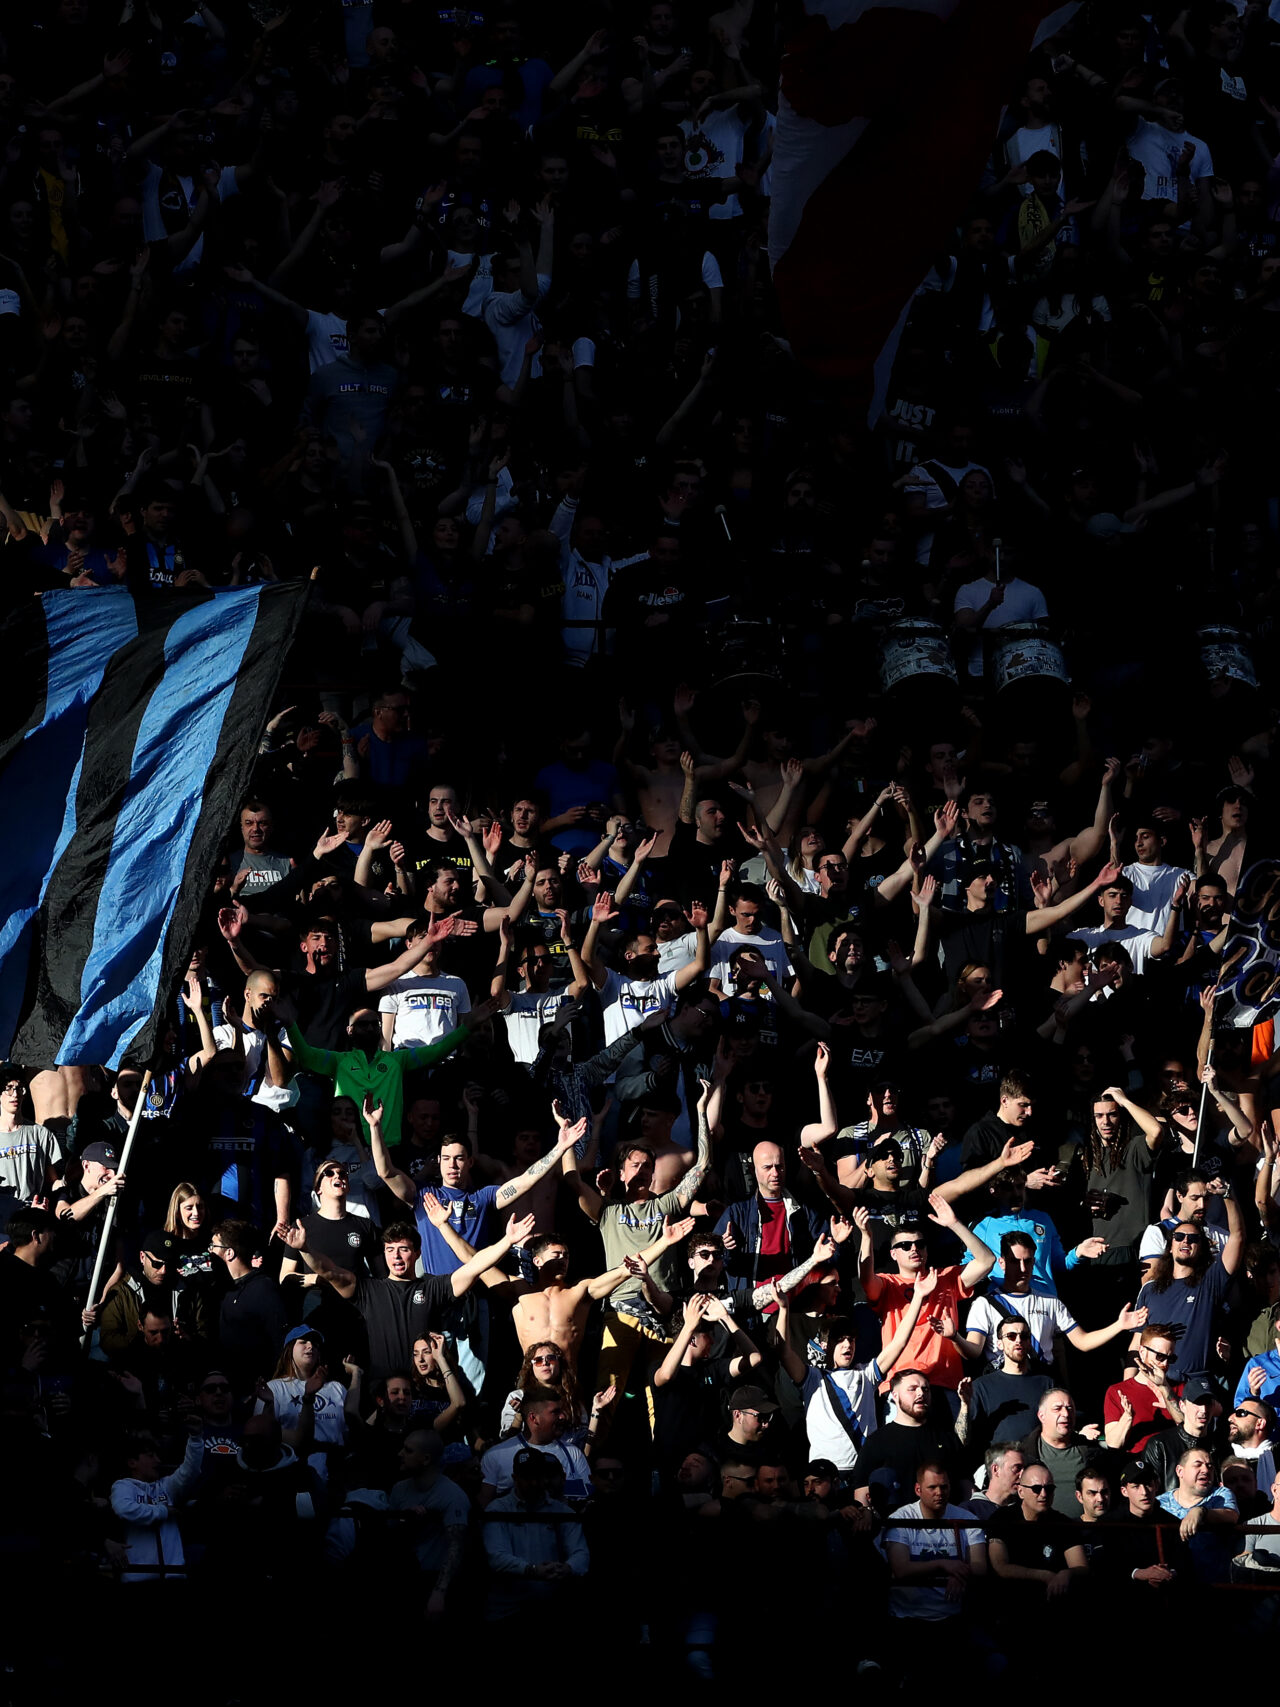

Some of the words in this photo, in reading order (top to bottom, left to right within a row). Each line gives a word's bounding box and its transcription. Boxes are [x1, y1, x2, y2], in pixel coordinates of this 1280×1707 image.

[889, 399, 936, 427] JUST
[408, 996, 427, 1007] CN
[851, 1049, 883, 1064] EA7
